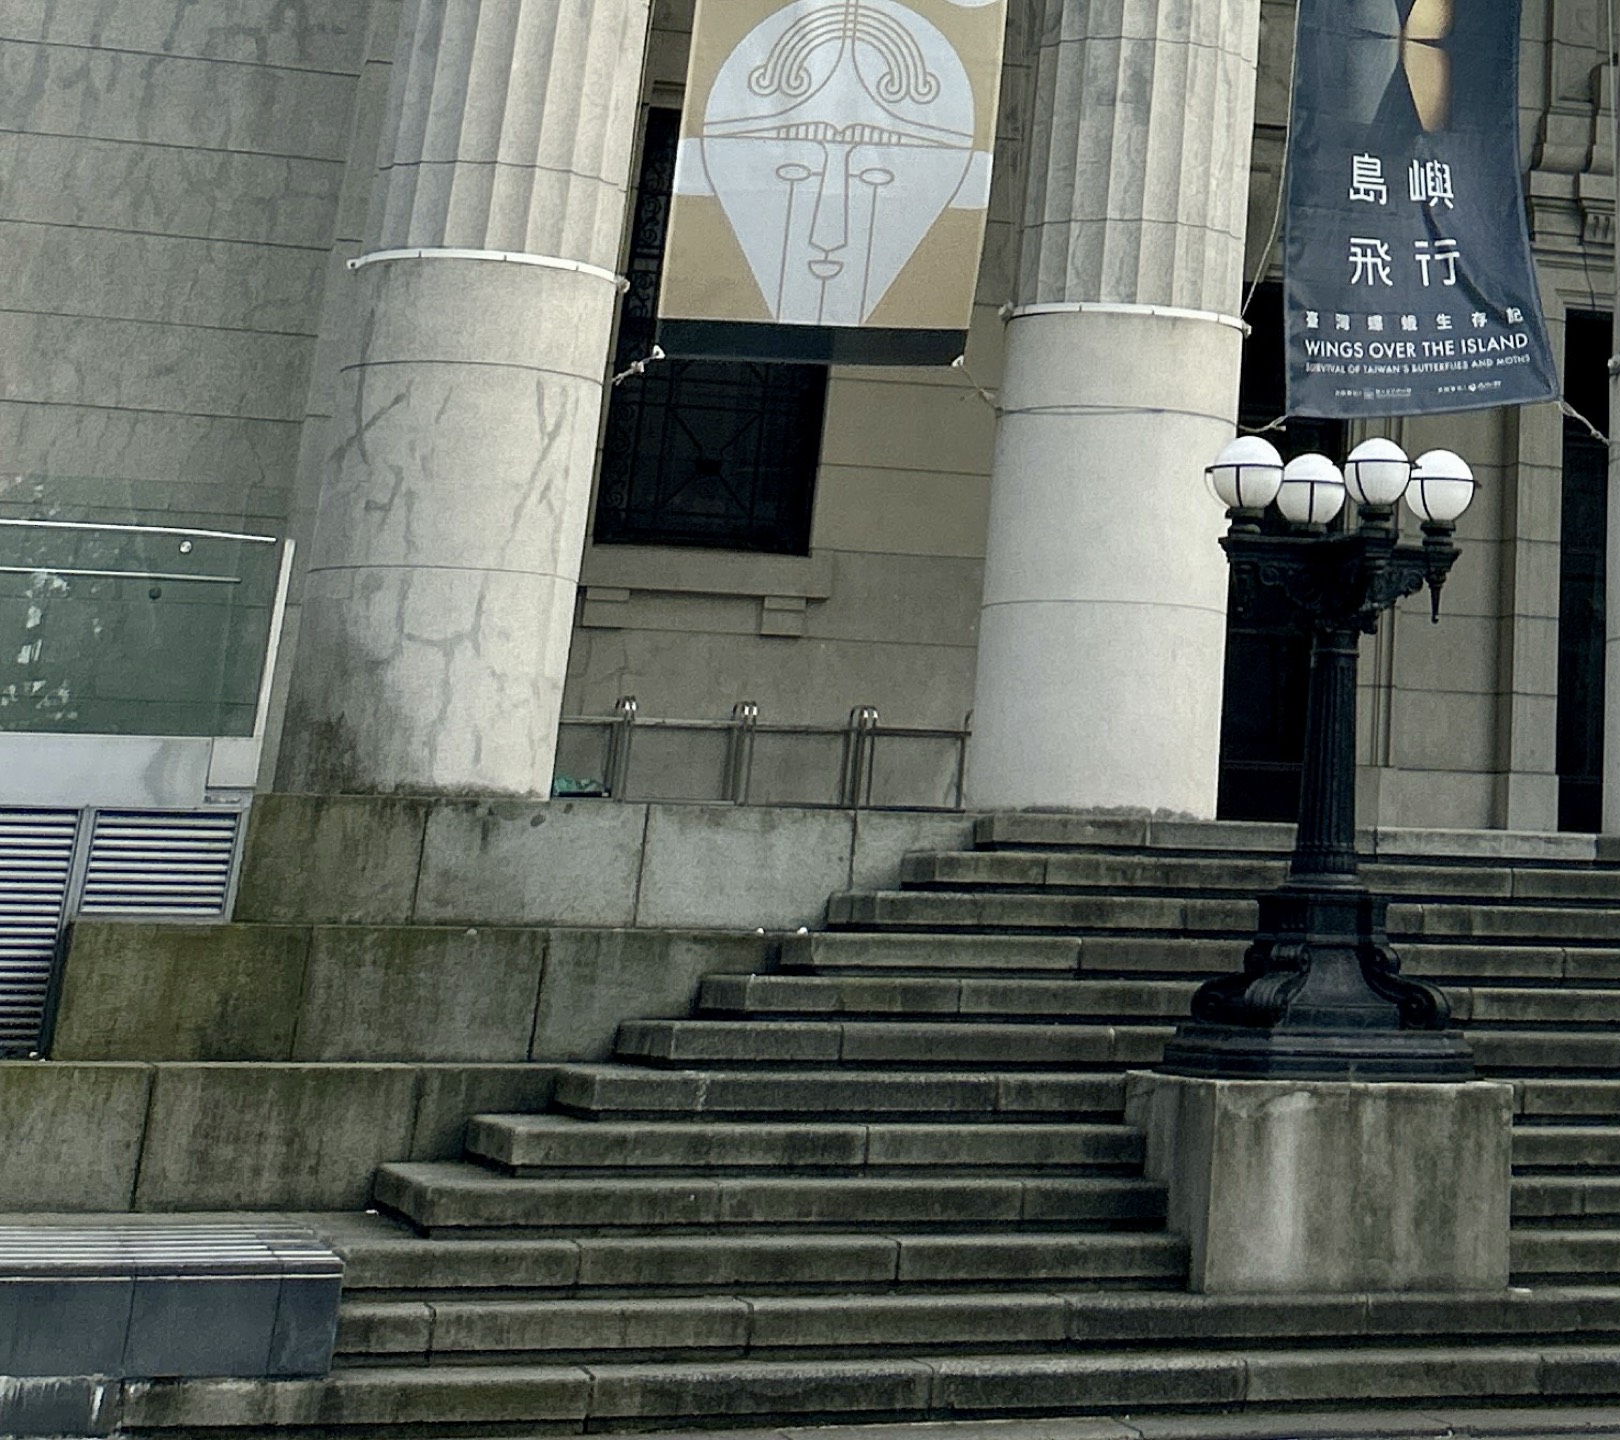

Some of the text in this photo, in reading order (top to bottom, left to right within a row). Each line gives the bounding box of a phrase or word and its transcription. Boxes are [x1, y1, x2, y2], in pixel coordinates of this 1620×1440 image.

[1349, 153, 1454, 210] 島嶼
[1349, 237, 1460, 287] 飛行
[1305, 333, 1529, 359] WINGS OVER THE ISLAND
[1471, 359, 1493, 369] AND
